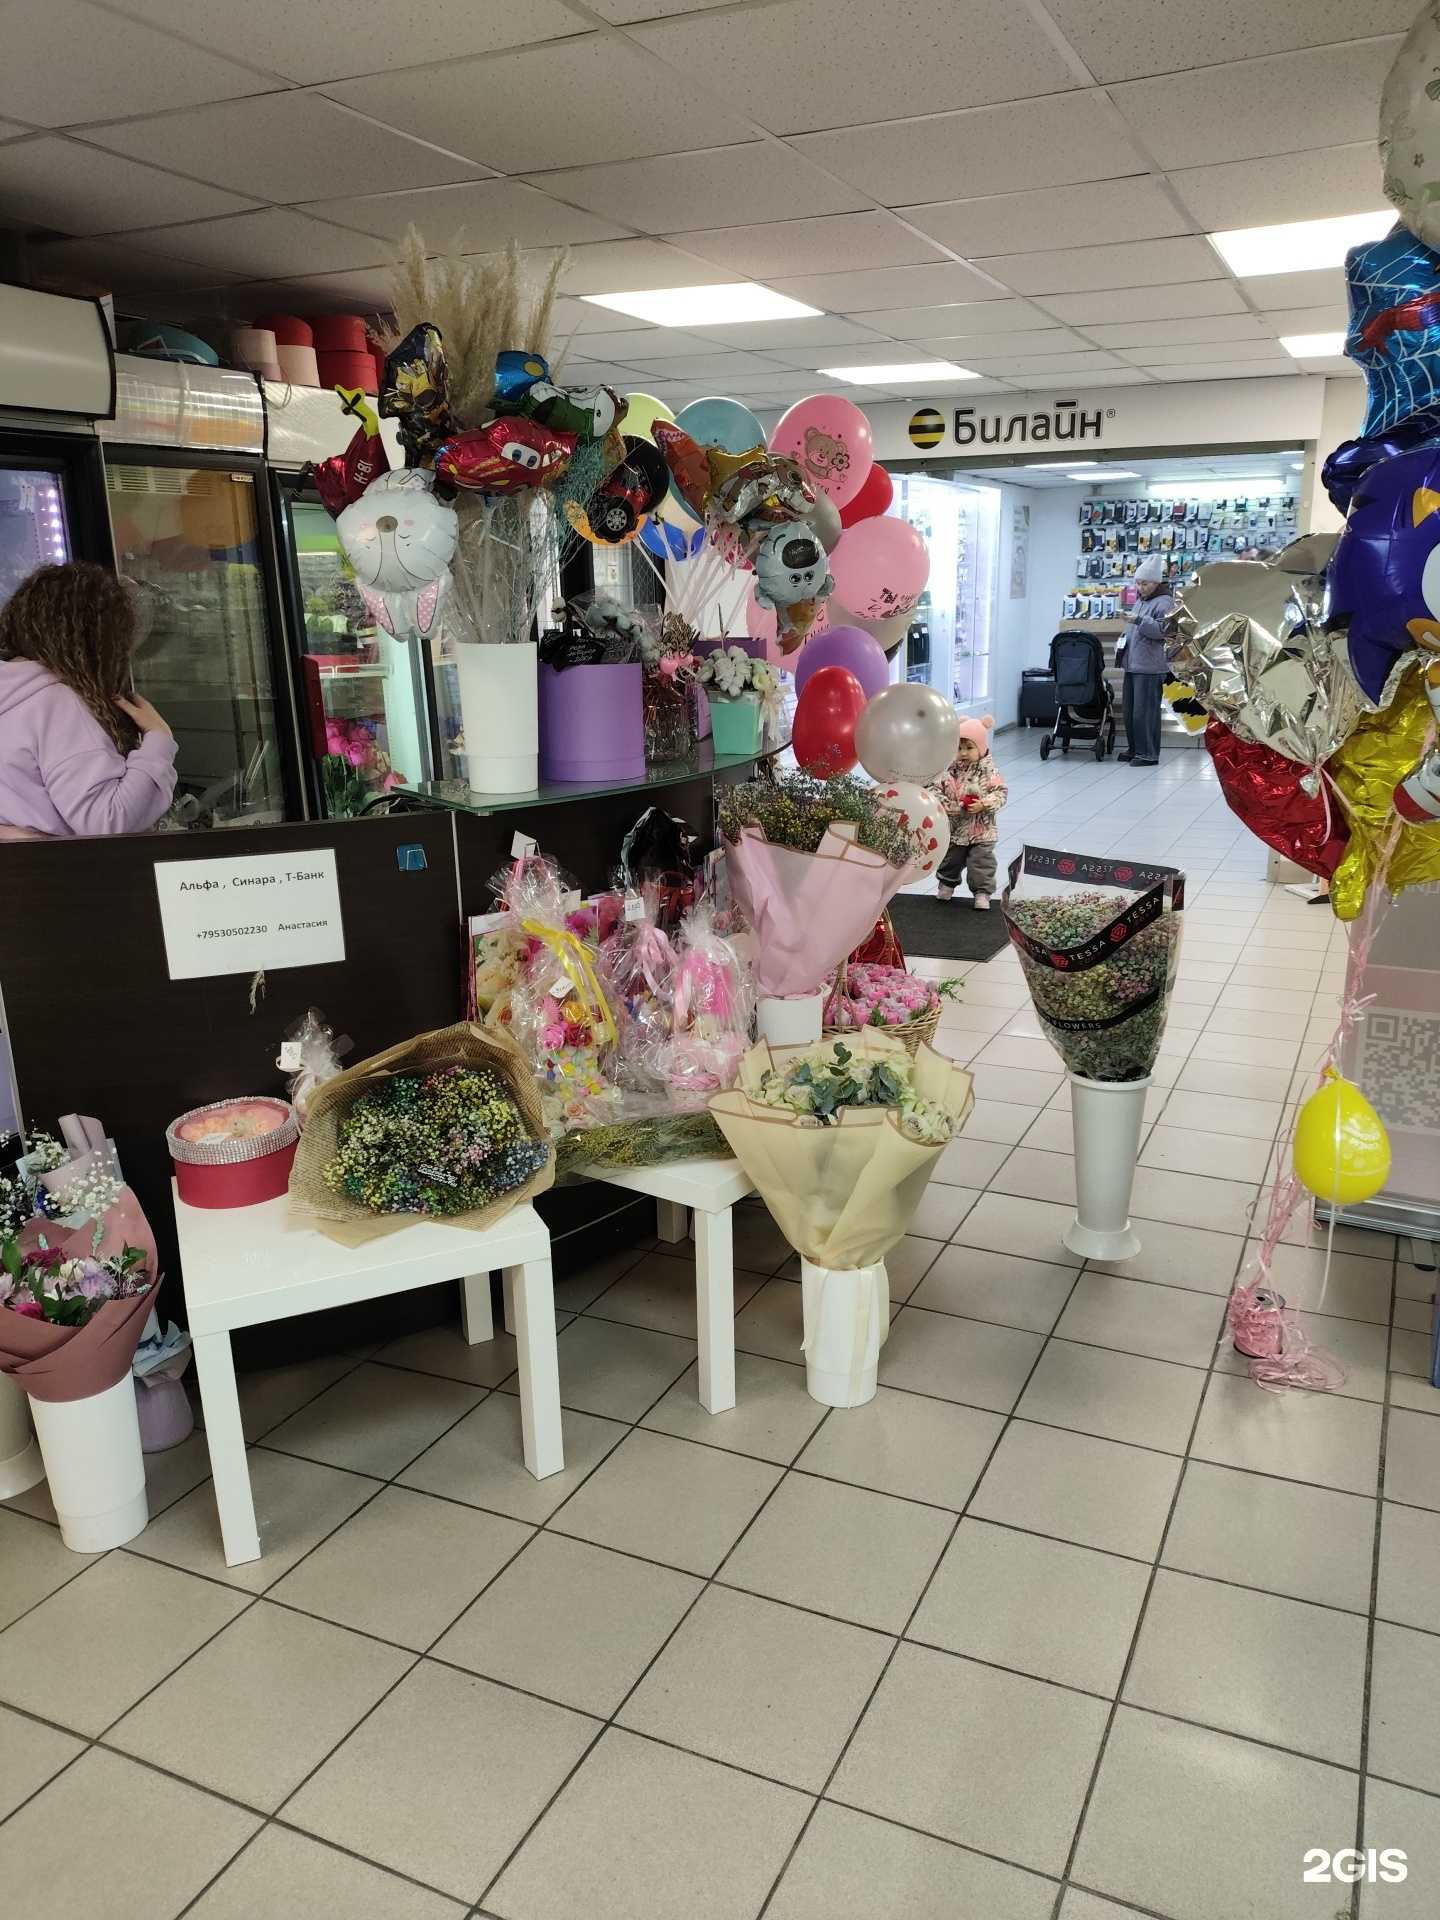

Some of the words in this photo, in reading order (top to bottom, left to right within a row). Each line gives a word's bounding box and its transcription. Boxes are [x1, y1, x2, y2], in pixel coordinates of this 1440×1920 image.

[285, 870, 326, 883] Т-Банк
[1126, 896, 1161, 924] TESSA
[197, 924, 269, 940] +79530502230
[278, 918, 329, 933] Анастасия
[1069, 940, 1107, 961] TESSA
